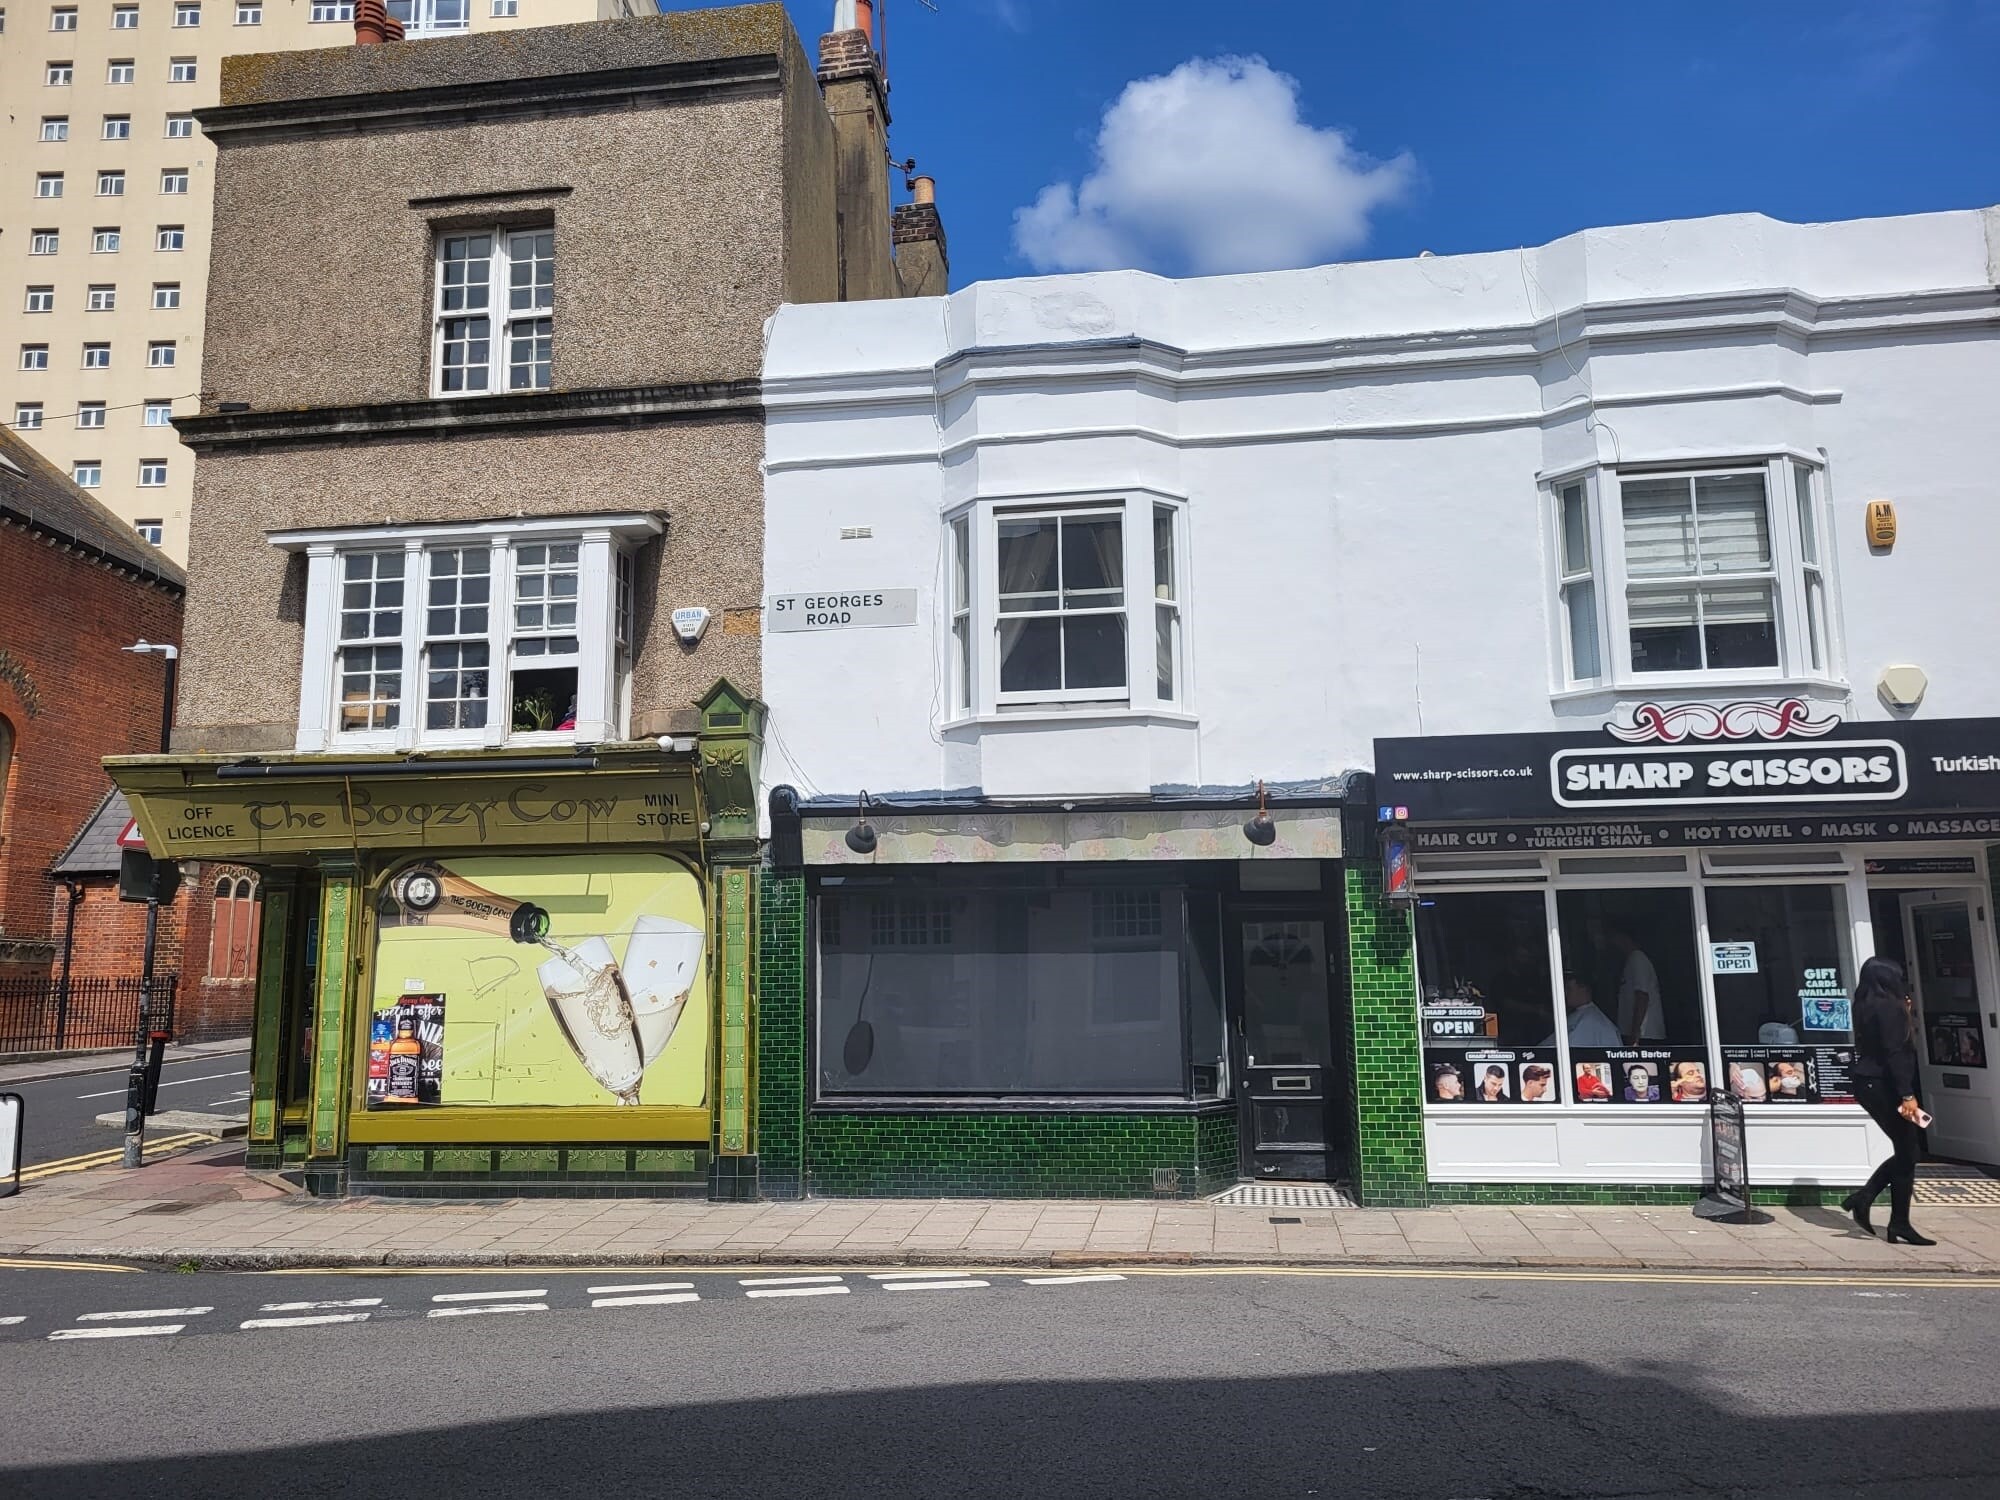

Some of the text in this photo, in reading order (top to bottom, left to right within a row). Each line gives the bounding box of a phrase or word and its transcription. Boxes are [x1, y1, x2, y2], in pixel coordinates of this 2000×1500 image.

[776, 594, 883, 611] ST GEORGES
[675, 610, 702, 620] URBAN
[806, 612, 851, 625] ROAD
[1931, 755, 2000, 772] Turkish
[1393, 765, 1533, 781] www.sharp-scissors.co.uk
[1566, 755, 1893, 790] SHARP SCISSORS
[644, 793, 680, 807] MINI
[184, 807, 213, 820] OFF
[242, 783, 618, 842] The Boozy Cow
[636, 812, 691, 826] STORE
[167, 825, 235, 840] LICENCE
[1533, 825, 1642, 837] TRADITIONAL
[1684, 825, 1792, 840] HOT TOWEL
[1821, 823, 1878, 838] MASK
[1907, 819, 2000, 835] MASSAGE
[1417, 832, 1498, 846] HAIR CUT
[1525, 834, 1653, 848] TURKISH SHAVE
[450, 894, 465, 906] THE
[466, 900, 493, 916] BOOZY
[493, 907, 512, 920] COW
[1717, 959, 1751, 969] OPEN
[1804, 968, 1837, 980] GIFT
[1806, 980, 1838, 988] CARDS
[1798, 989, 1848, 997] AVAILABLE
[417, 1003, 444, 1020] offer
[1432, 1021, 1475, 1034] OPEN
[1606, 1050, 1672, 1058] Turkish Barber
